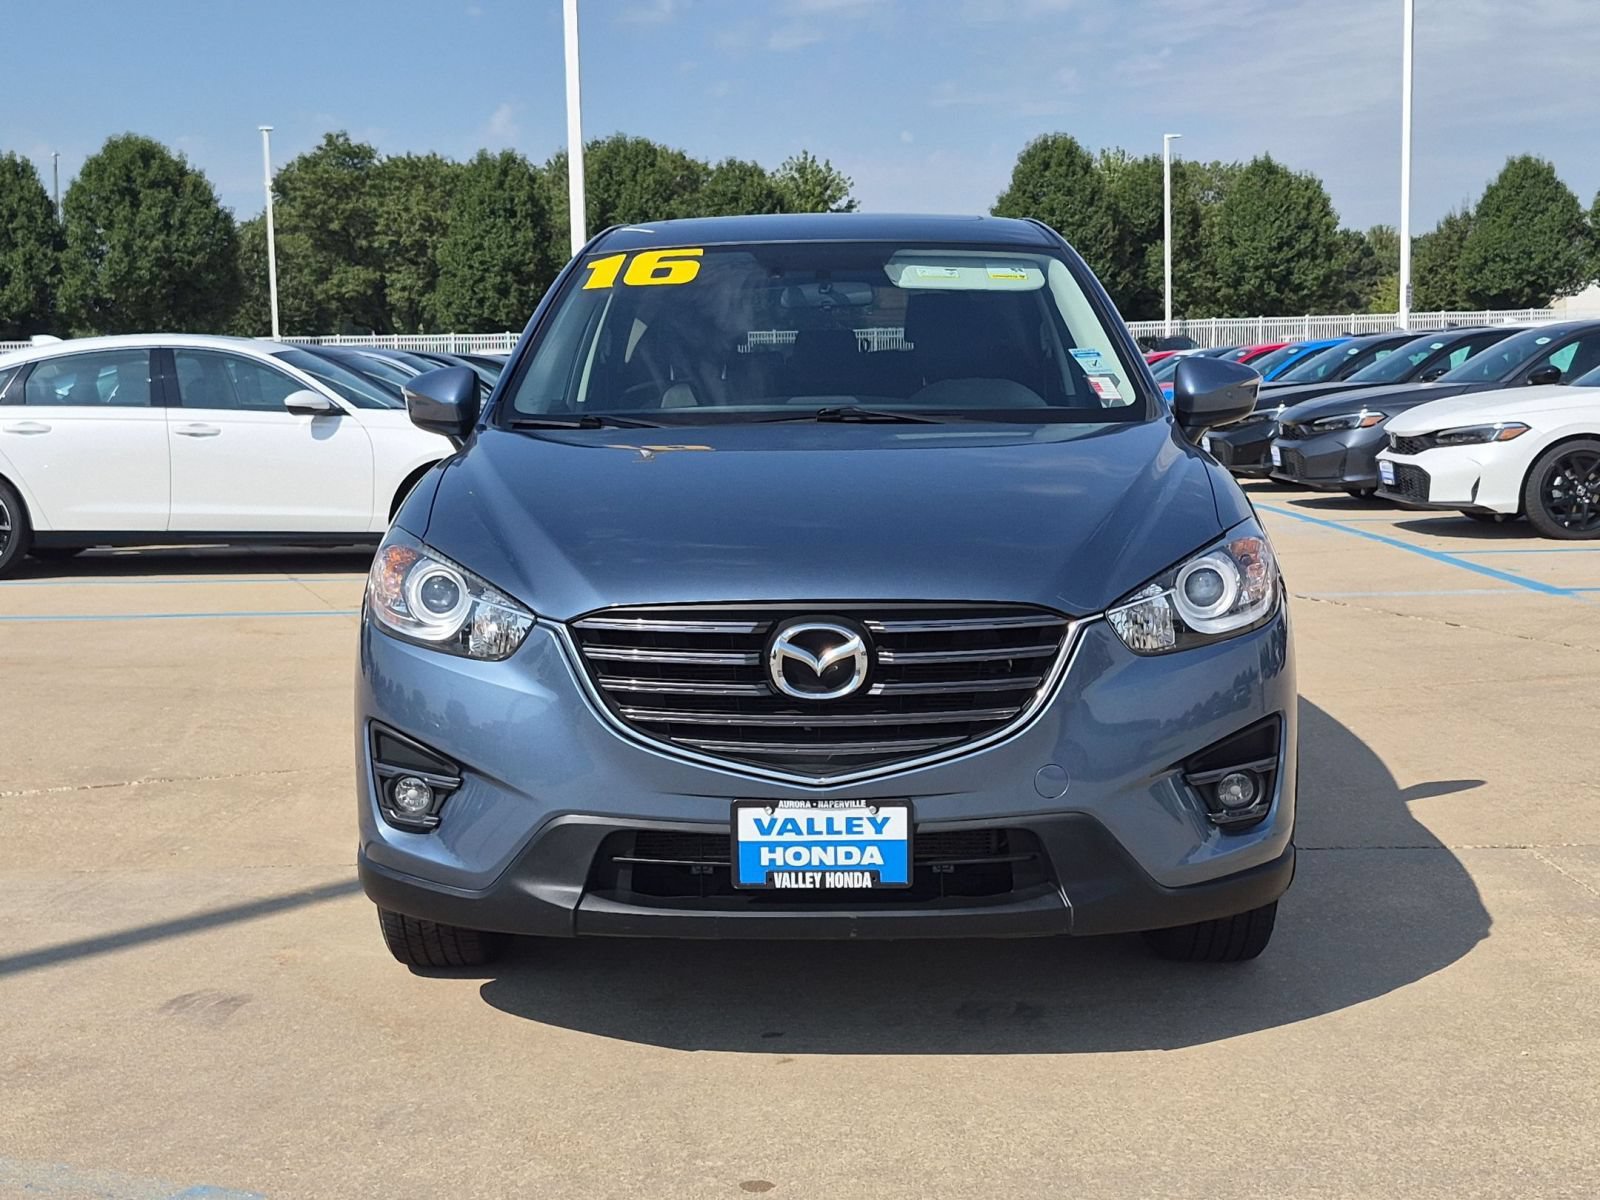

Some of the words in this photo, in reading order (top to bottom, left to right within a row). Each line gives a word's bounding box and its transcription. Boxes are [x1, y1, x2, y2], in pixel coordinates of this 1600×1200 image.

[582, 248, 704, 290] 16
[778, 800, 811, 808] AURORA
[818, 800, 866, 808] NAPERVILLE
[753, 816, 891, 836] VALLEY
[760, 846, 884, 866] HONDA
[774, 872, 822, 888] VALLEY
[826, 872, 872, 888] HONDA
